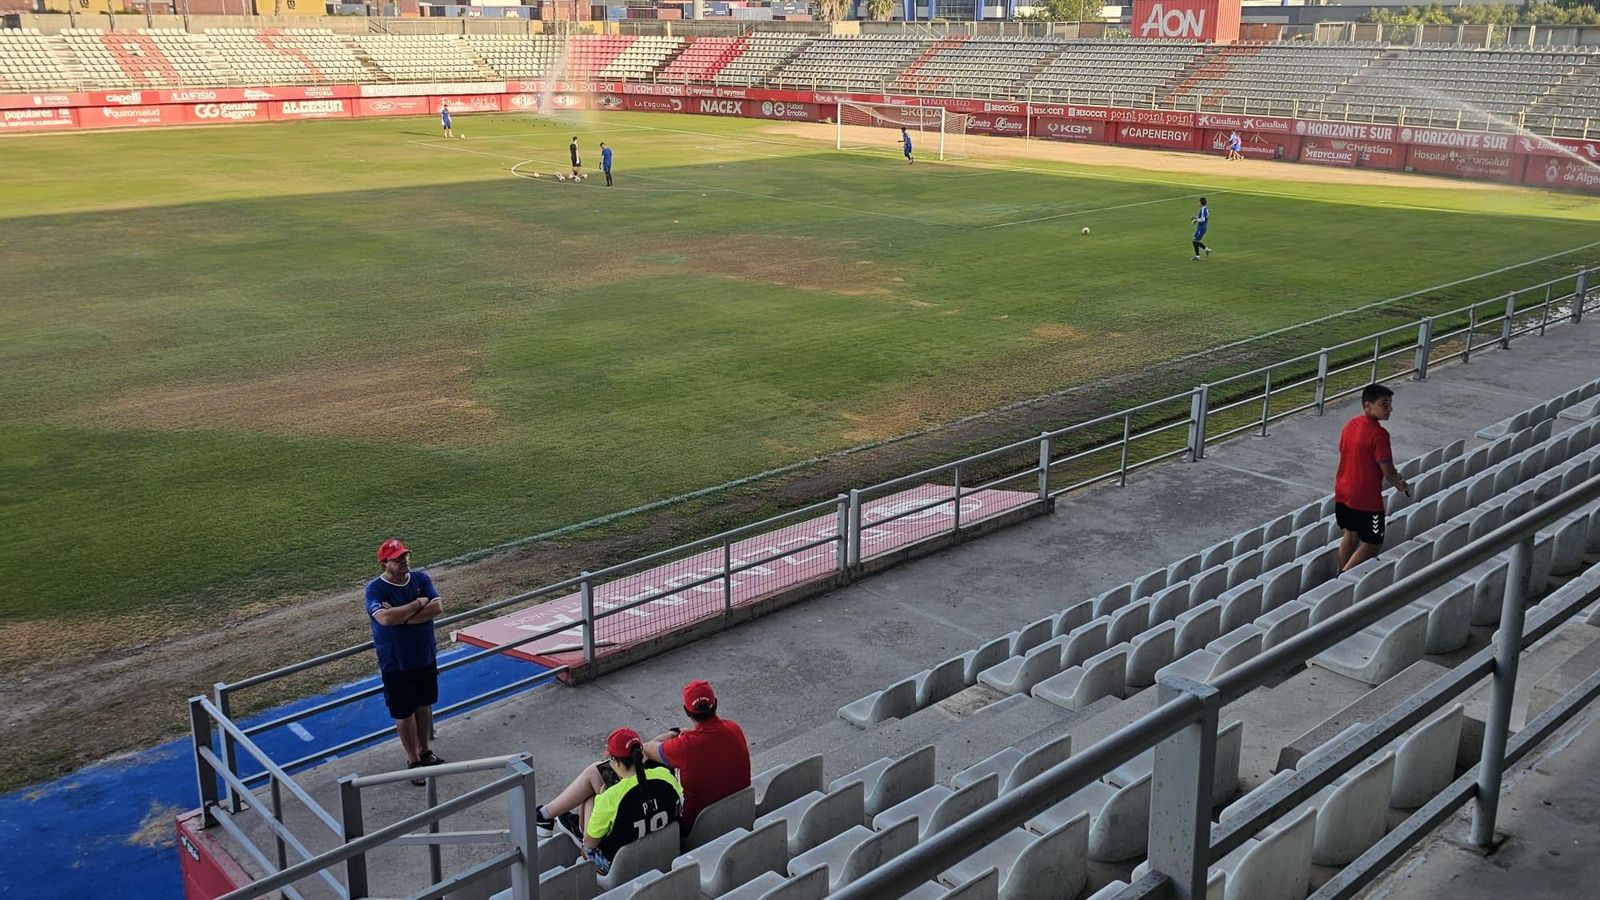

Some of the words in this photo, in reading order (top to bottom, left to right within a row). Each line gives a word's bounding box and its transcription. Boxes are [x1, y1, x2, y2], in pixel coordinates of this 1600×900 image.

[1141, 3, 1206, 37] AON
[633, 85, 653, 93] ICOM
[662, 86, 682, 94] ICOM
[700, 100, 743, 114] NACEX
[1210, 116, 1240, 127] CaixaBank
[1256, 119, 1288, 130] CaixaBank
[1060, 124, 1092, 134] KGM
[1128, 127, 1188, 142] CAPENERGY
[1308, 122, 1368, 139] HORIZONTE
[1370, 126, 1392, 140] SUR
[1414, 130, 1480, 148] HORIZONTE
[1483, 136, 1508, 150] SUR
[1306, 148, 1352, 160] MEDYCLINIC
[1346, 142, 1393, 155] Christian
[1414, 150, 1448, 160] Hospital
[1564, 172, 1575, 180] de
[1576, 172, 1600, 185] Alge
